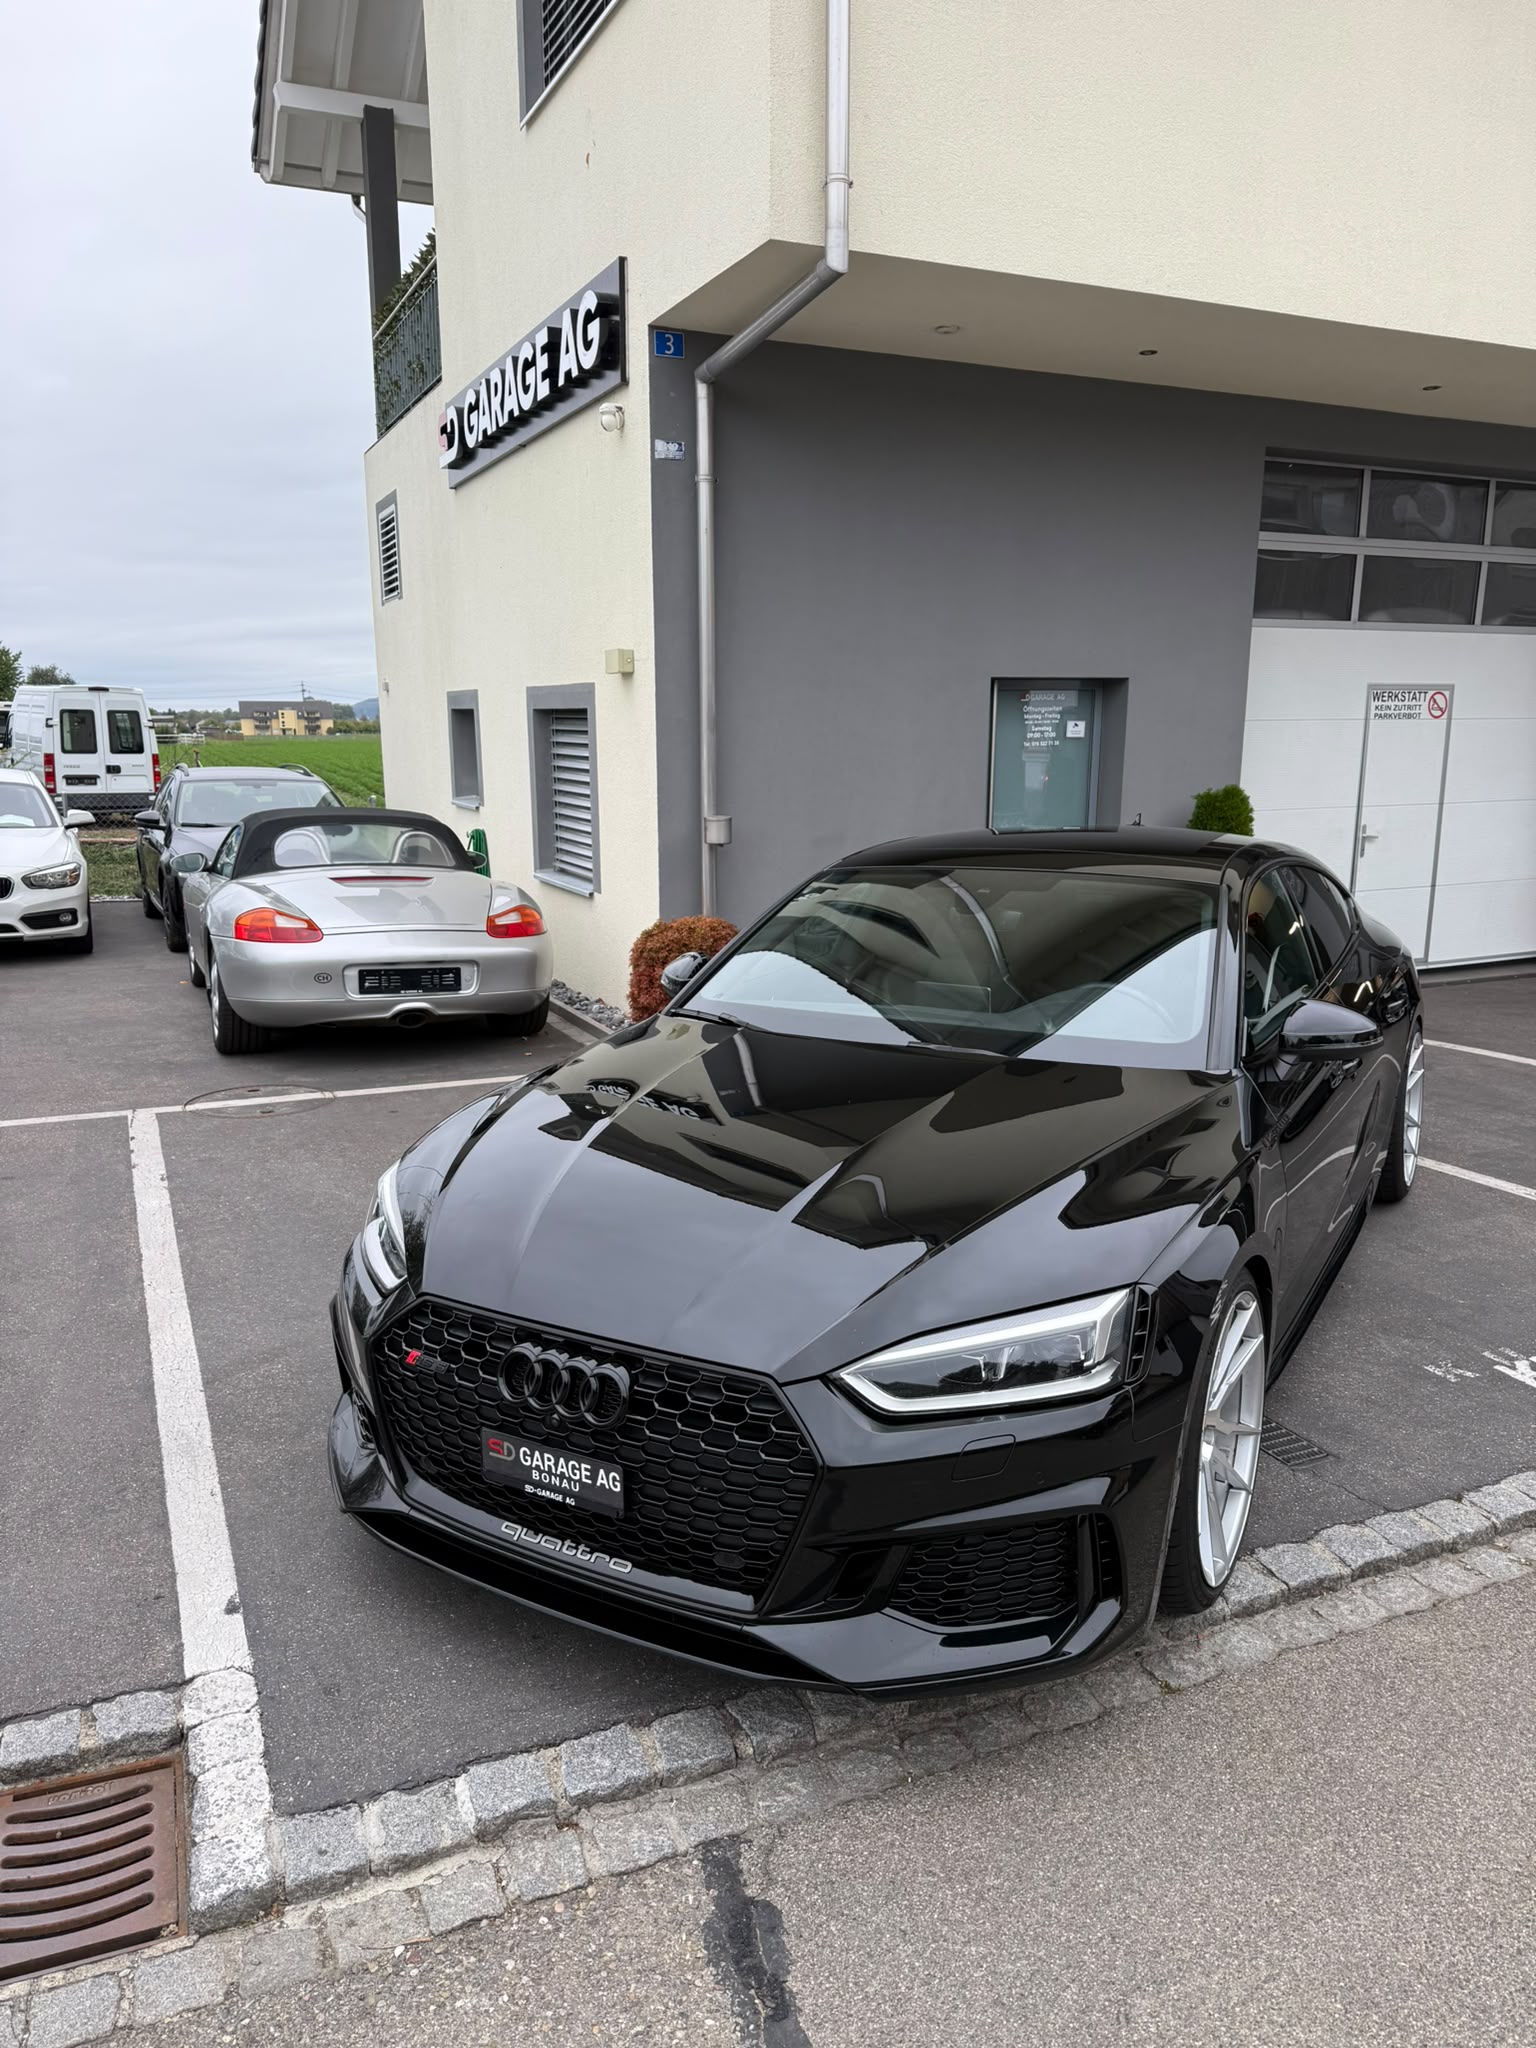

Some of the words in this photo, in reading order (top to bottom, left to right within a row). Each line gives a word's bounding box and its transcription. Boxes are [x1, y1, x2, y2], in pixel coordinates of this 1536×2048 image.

[663, 332, 675, 356] 3
[463, 325, 551, 449] GARAGE
[558, 289, 601, 388] AG
[1372, 691, 1429, 703] WERKSTATT
[1374, 704, 1392, 712] KEIN
[1393, 704, 1422, 712] ZUTRITT
[1373, 712, 1422, 720] PARKVERBOT
[486, 1437, 516, 1462] SD
[519, 1446, 592, 1484] GARAGE
[596, 1468, 621, 1493] AG
[532, 1469, 580, 1492] BONAU
[500, 1520, 633, 1574] quattro
